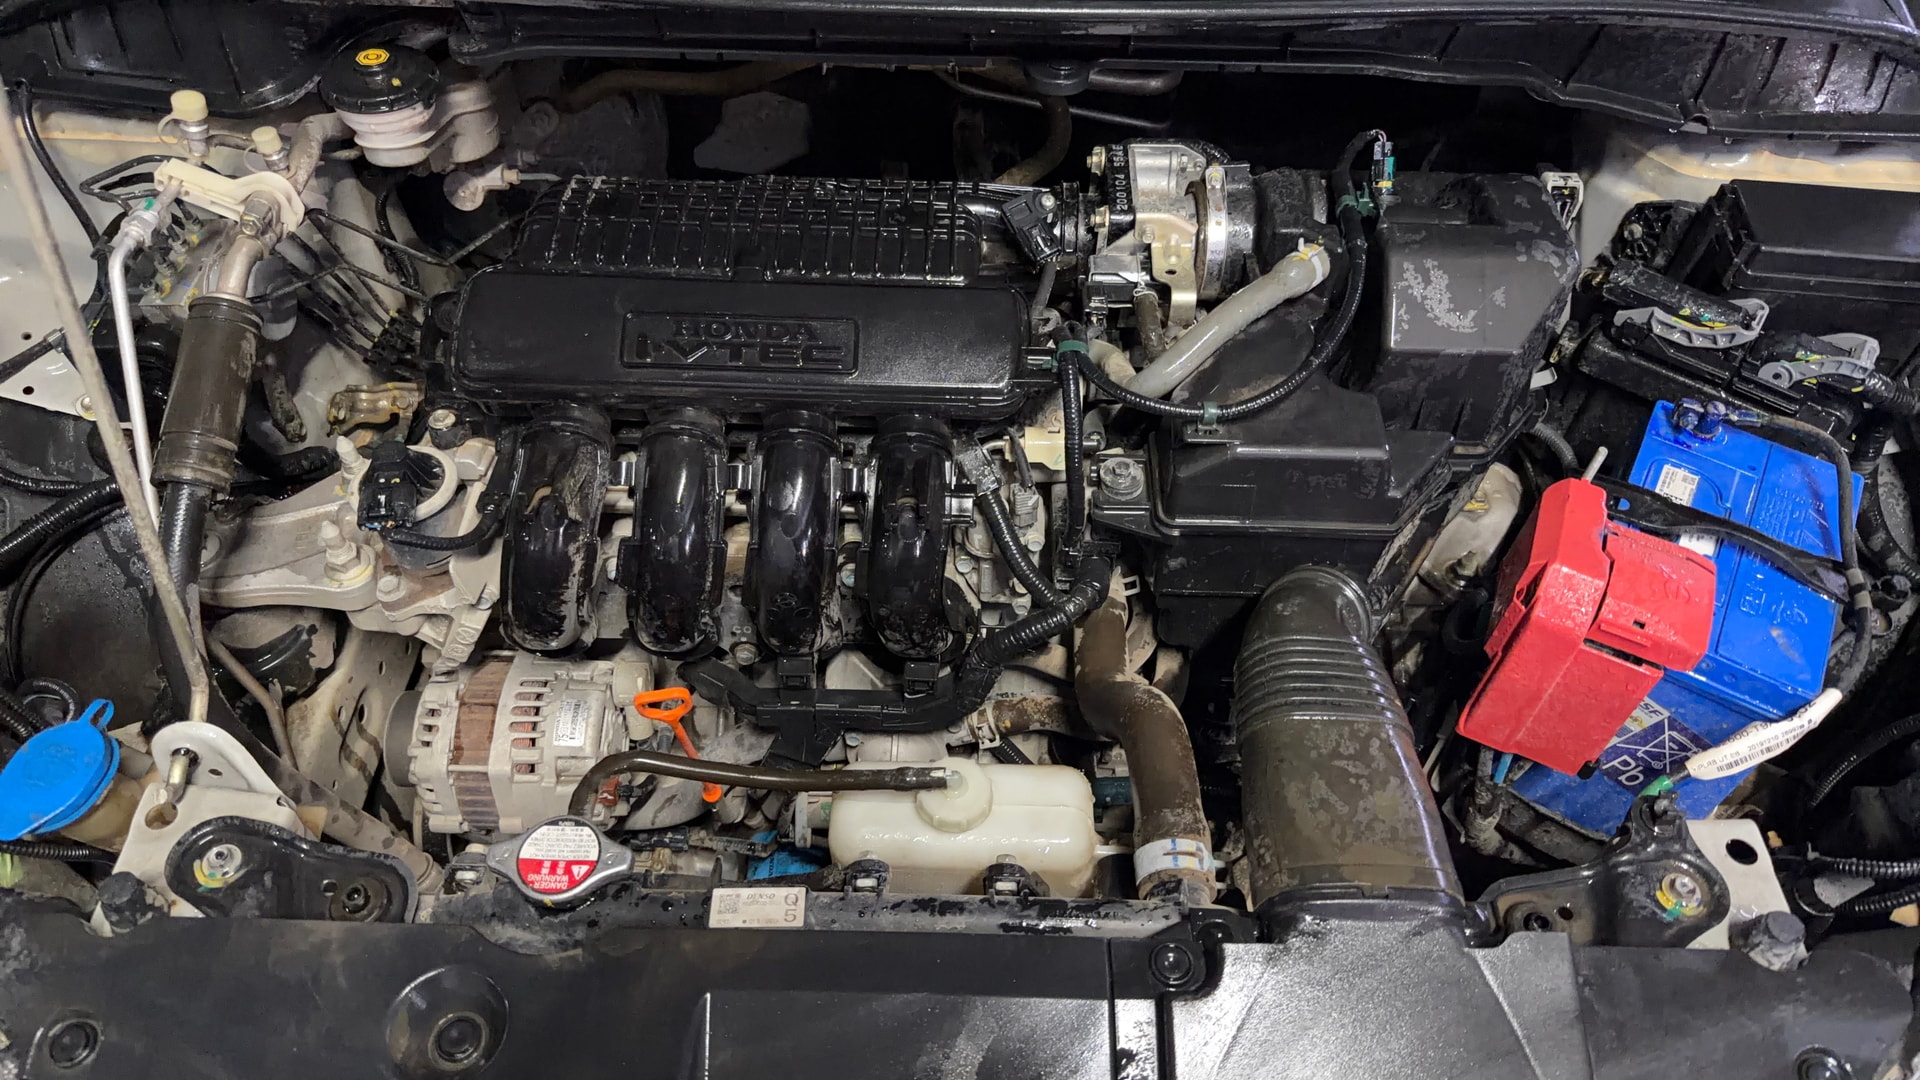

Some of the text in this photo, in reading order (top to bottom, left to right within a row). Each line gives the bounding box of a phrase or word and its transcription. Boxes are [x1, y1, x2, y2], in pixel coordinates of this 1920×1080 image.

[1114, 174, 1128, 210] 200104
[673, 321, 822, 344] HONDA
[1602, 754, 1644, 786] Pb
[528, 873, 569, 882] WARNUNG
[534, 881, 568, 889] DANGER
[784, 893, 799, 906] Q
[784, 909, 797, 923] 5
